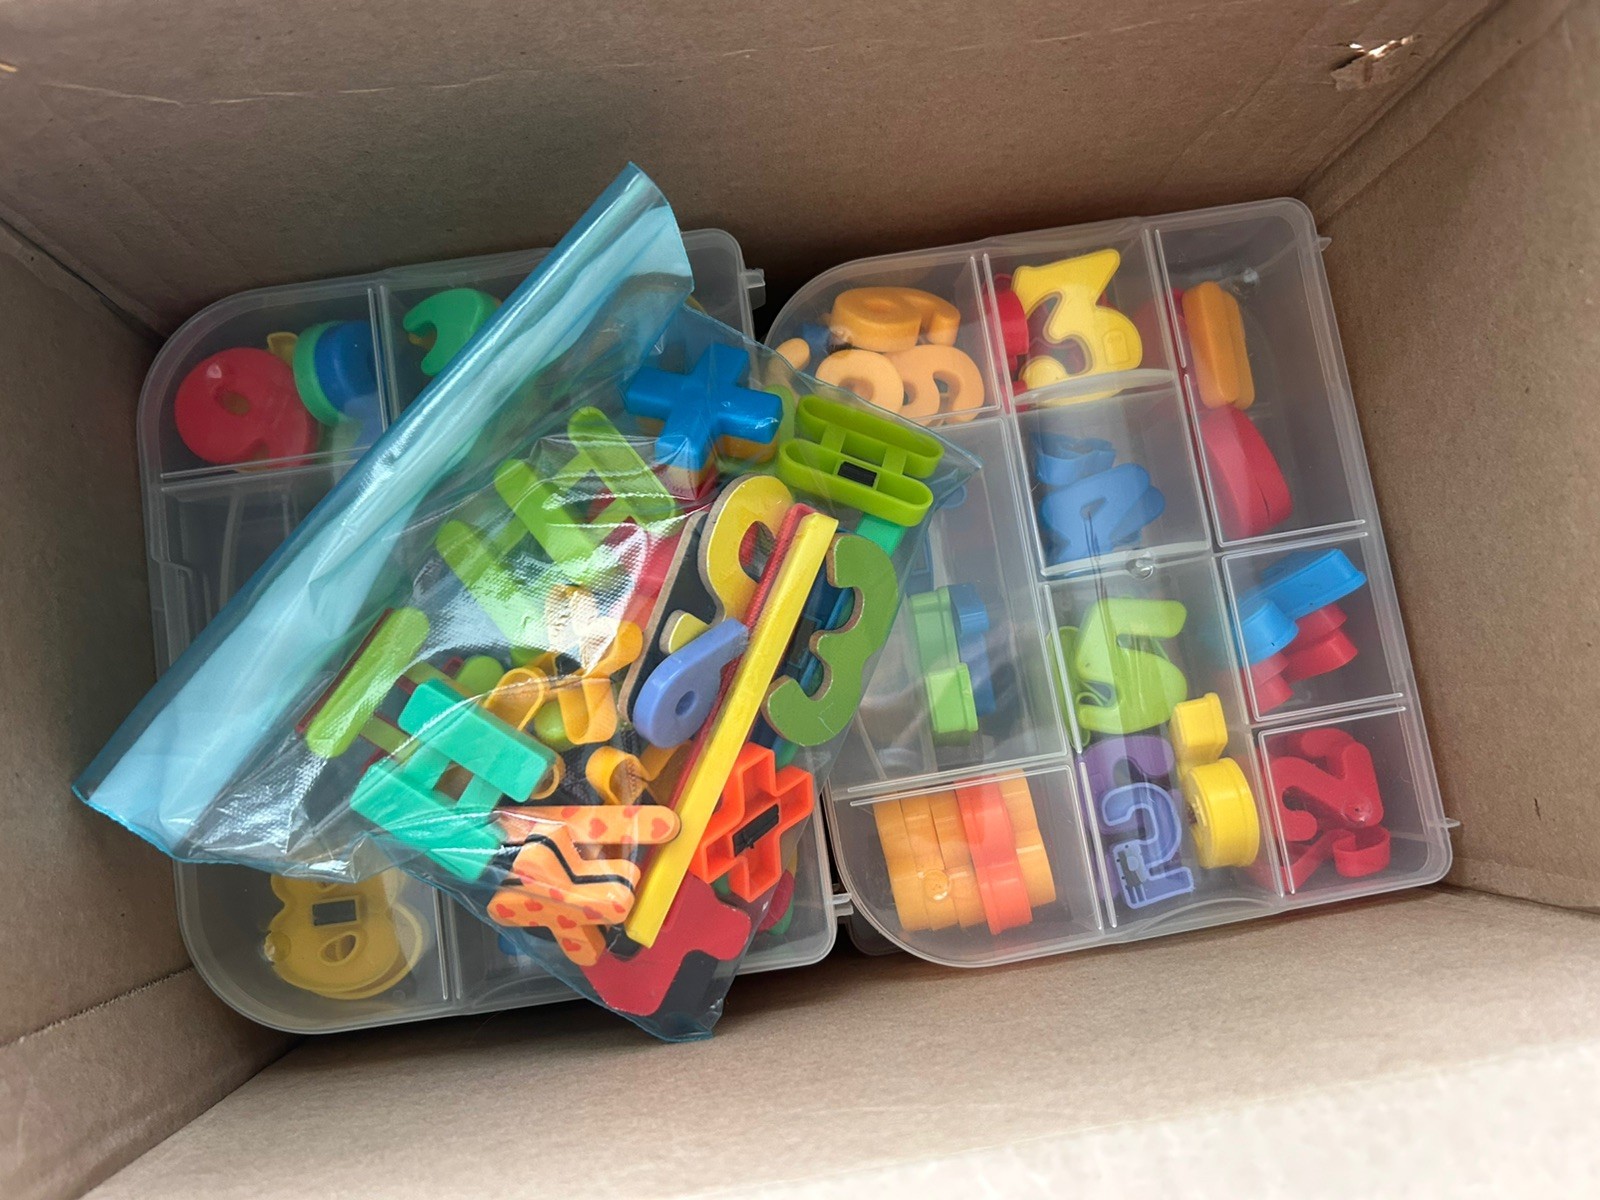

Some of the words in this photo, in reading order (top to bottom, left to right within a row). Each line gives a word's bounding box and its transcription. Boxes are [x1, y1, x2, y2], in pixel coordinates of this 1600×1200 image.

[1011, 248, 1142, 388] 3
[761, 534, 898, 746] 3
[1074, 598, 1188, 734] 5
[1101, 782, 1194, 909] 2
